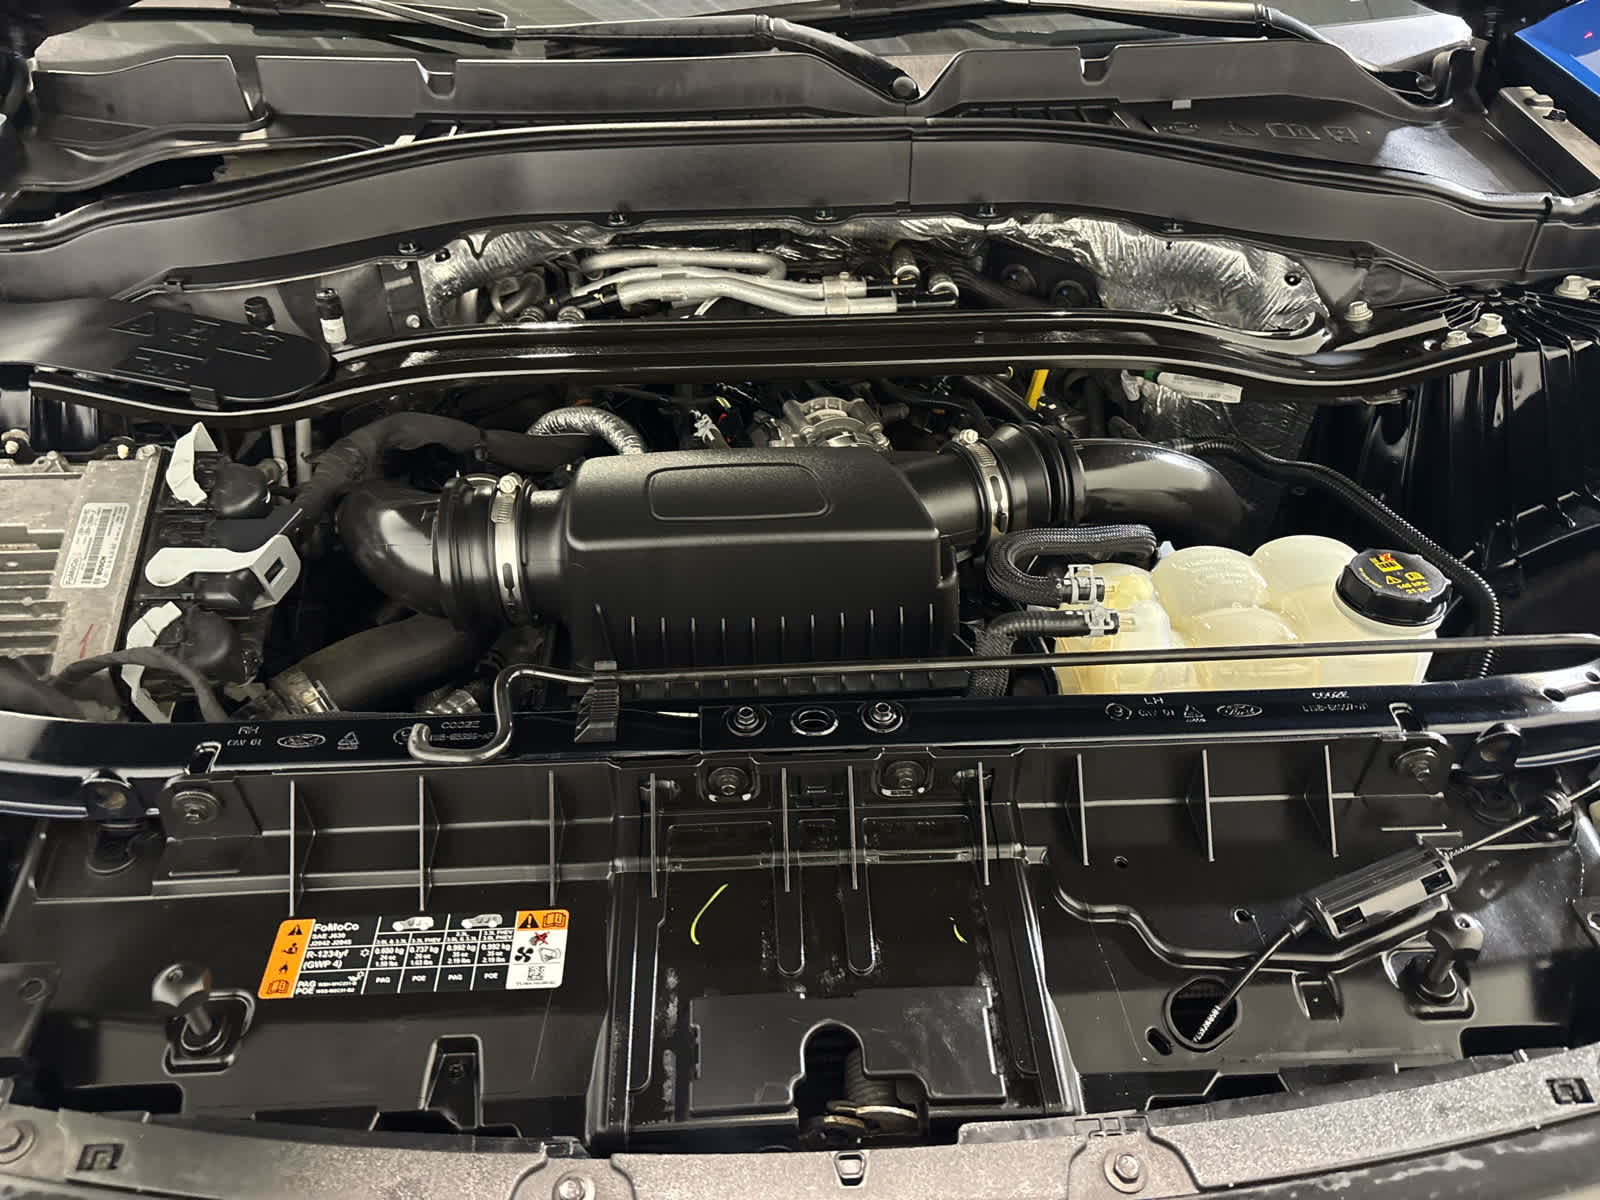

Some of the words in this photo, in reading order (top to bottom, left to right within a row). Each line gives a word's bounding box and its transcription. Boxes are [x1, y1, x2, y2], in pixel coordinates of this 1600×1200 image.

[314, 922, 360, 932] FoMoCo
[306, 949, 350, 960] R-1234yf
[302, 960, 332, 969] (GWP
[333, 959, 342, 968] 4)
[295, 987, 314, 995] POE
